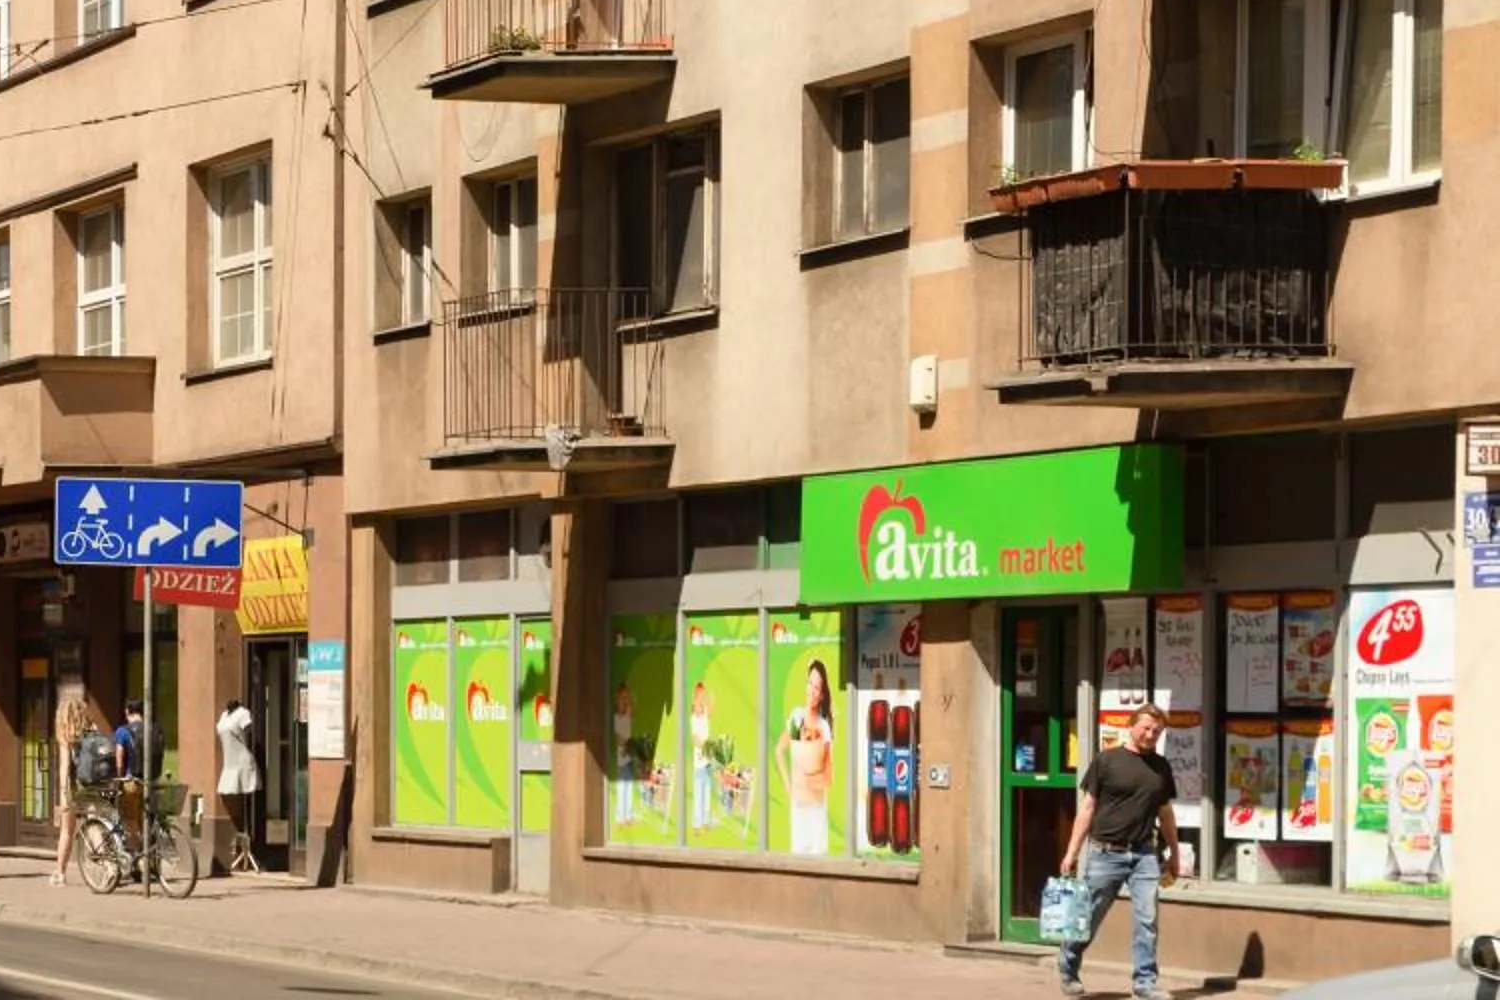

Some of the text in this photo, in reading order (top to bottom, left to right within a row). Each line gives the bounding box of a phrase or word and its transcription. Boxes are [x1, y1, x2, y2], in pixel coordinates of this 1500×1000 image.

[243, 546, 298, 582] ANIA
[874, 518, 1085, 582] avita market
